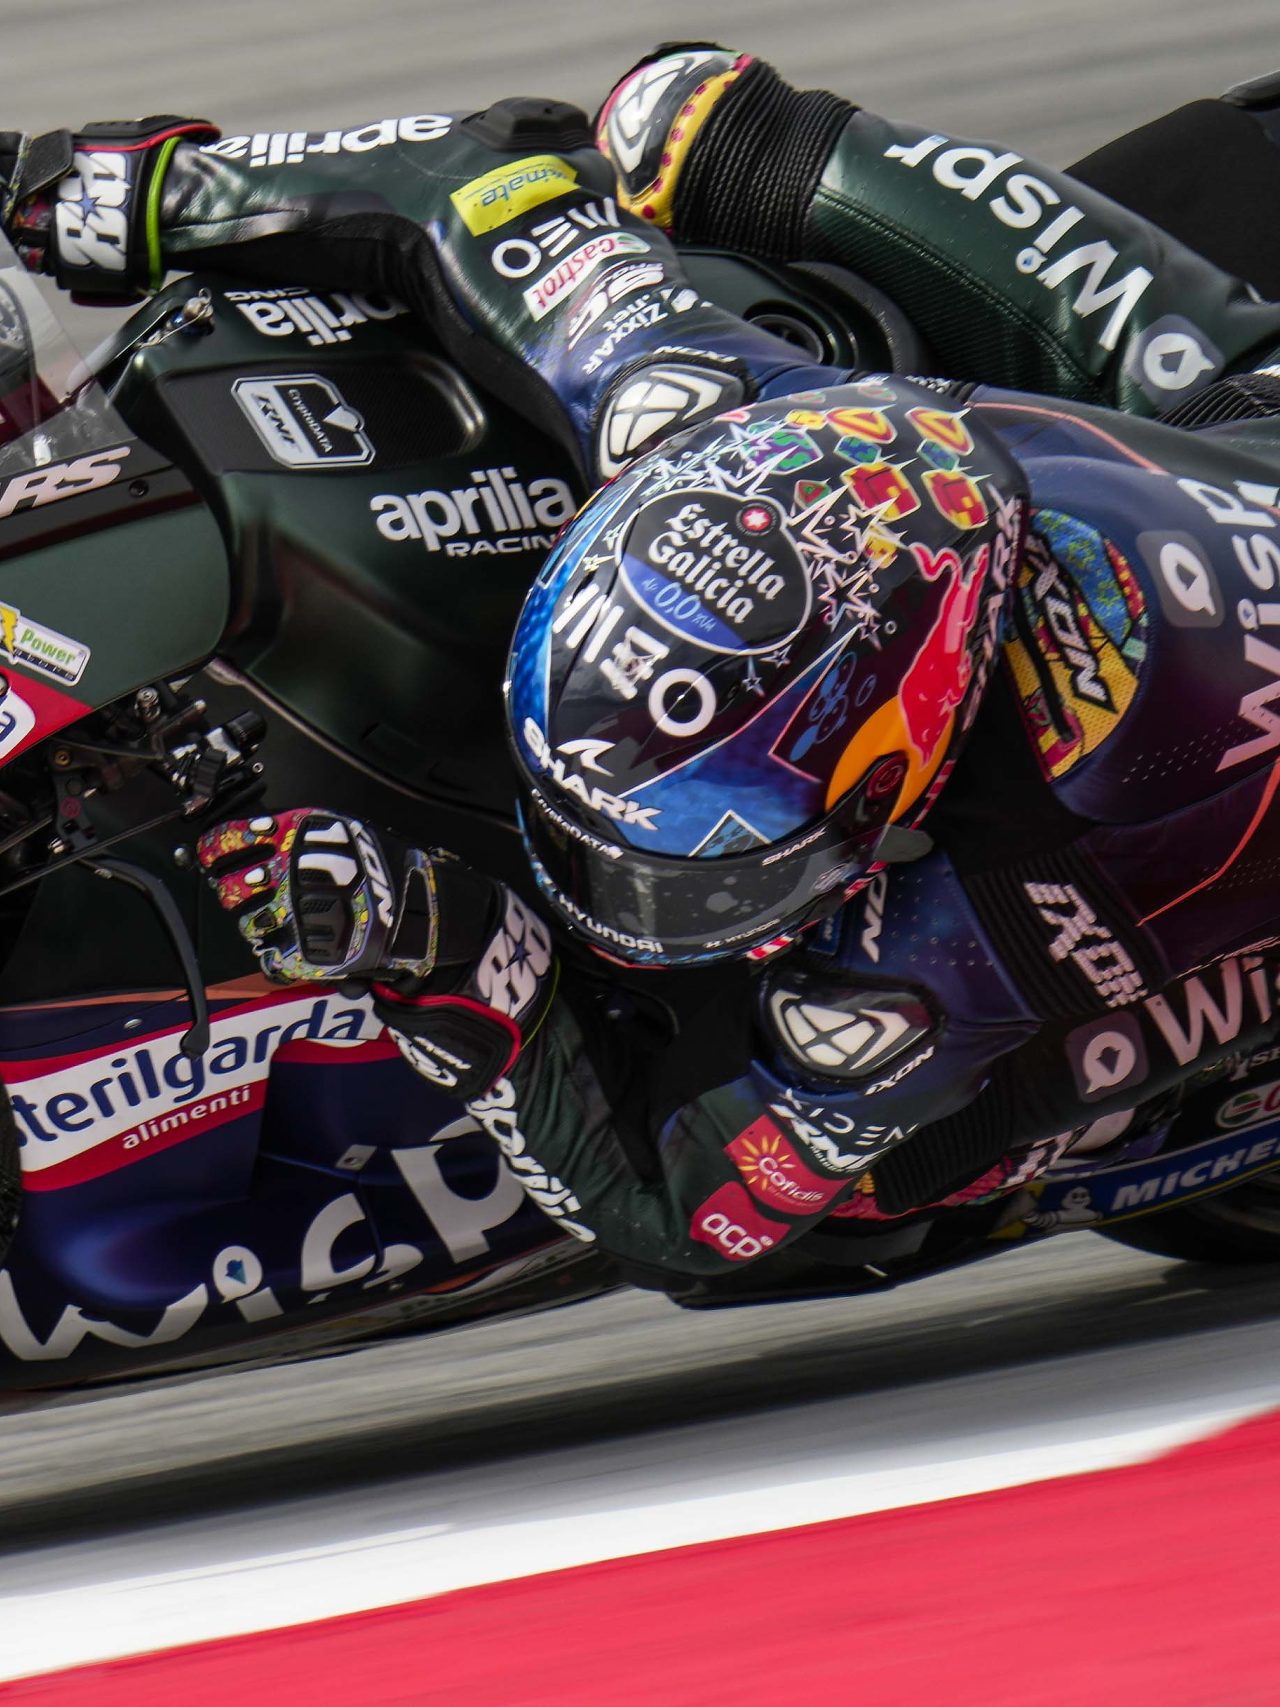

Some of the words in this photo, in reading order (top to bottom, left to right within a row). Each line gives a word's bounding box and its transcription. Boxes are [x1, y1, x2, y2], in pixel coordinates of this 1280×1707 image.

[199, 113, 453, 167] aprilia
[883, 134, 1155, 351] Wispr
[370, 466, 577, 552] aprilia
[445, 533, 558, 559] RACIN
[648, 531, 754, 624] Galicia
[665, 503, 786, 600] Estrella
[21, 628, 76, 665] Power
[523, 716, 663, 831] SHARK
[122, 1085, 252, 1150] alimenti
[1112, 1137, 1280, 1211] MICHE
